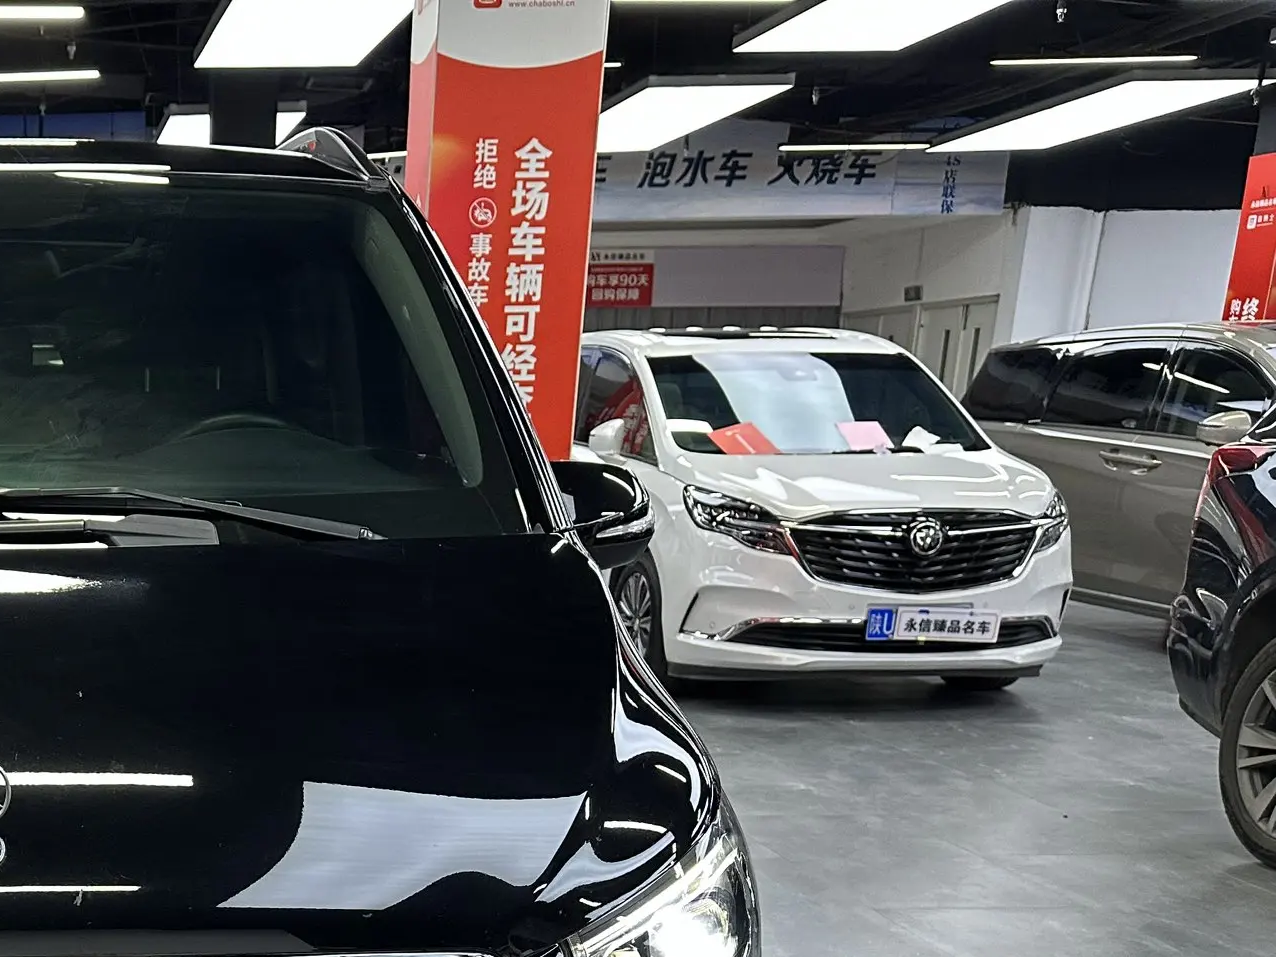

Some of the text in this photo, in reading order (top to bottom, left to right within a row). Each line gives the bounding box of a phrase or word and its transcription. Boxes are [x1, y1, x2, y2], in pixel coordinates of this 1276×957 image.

[637, 149, 753, 188] 泡水车
[767, 150, 883, 186] 火烧车
[468, 137, 499, 307] 拒绝 事故车
[904, 618, 991, 635] 永信臻品名车
